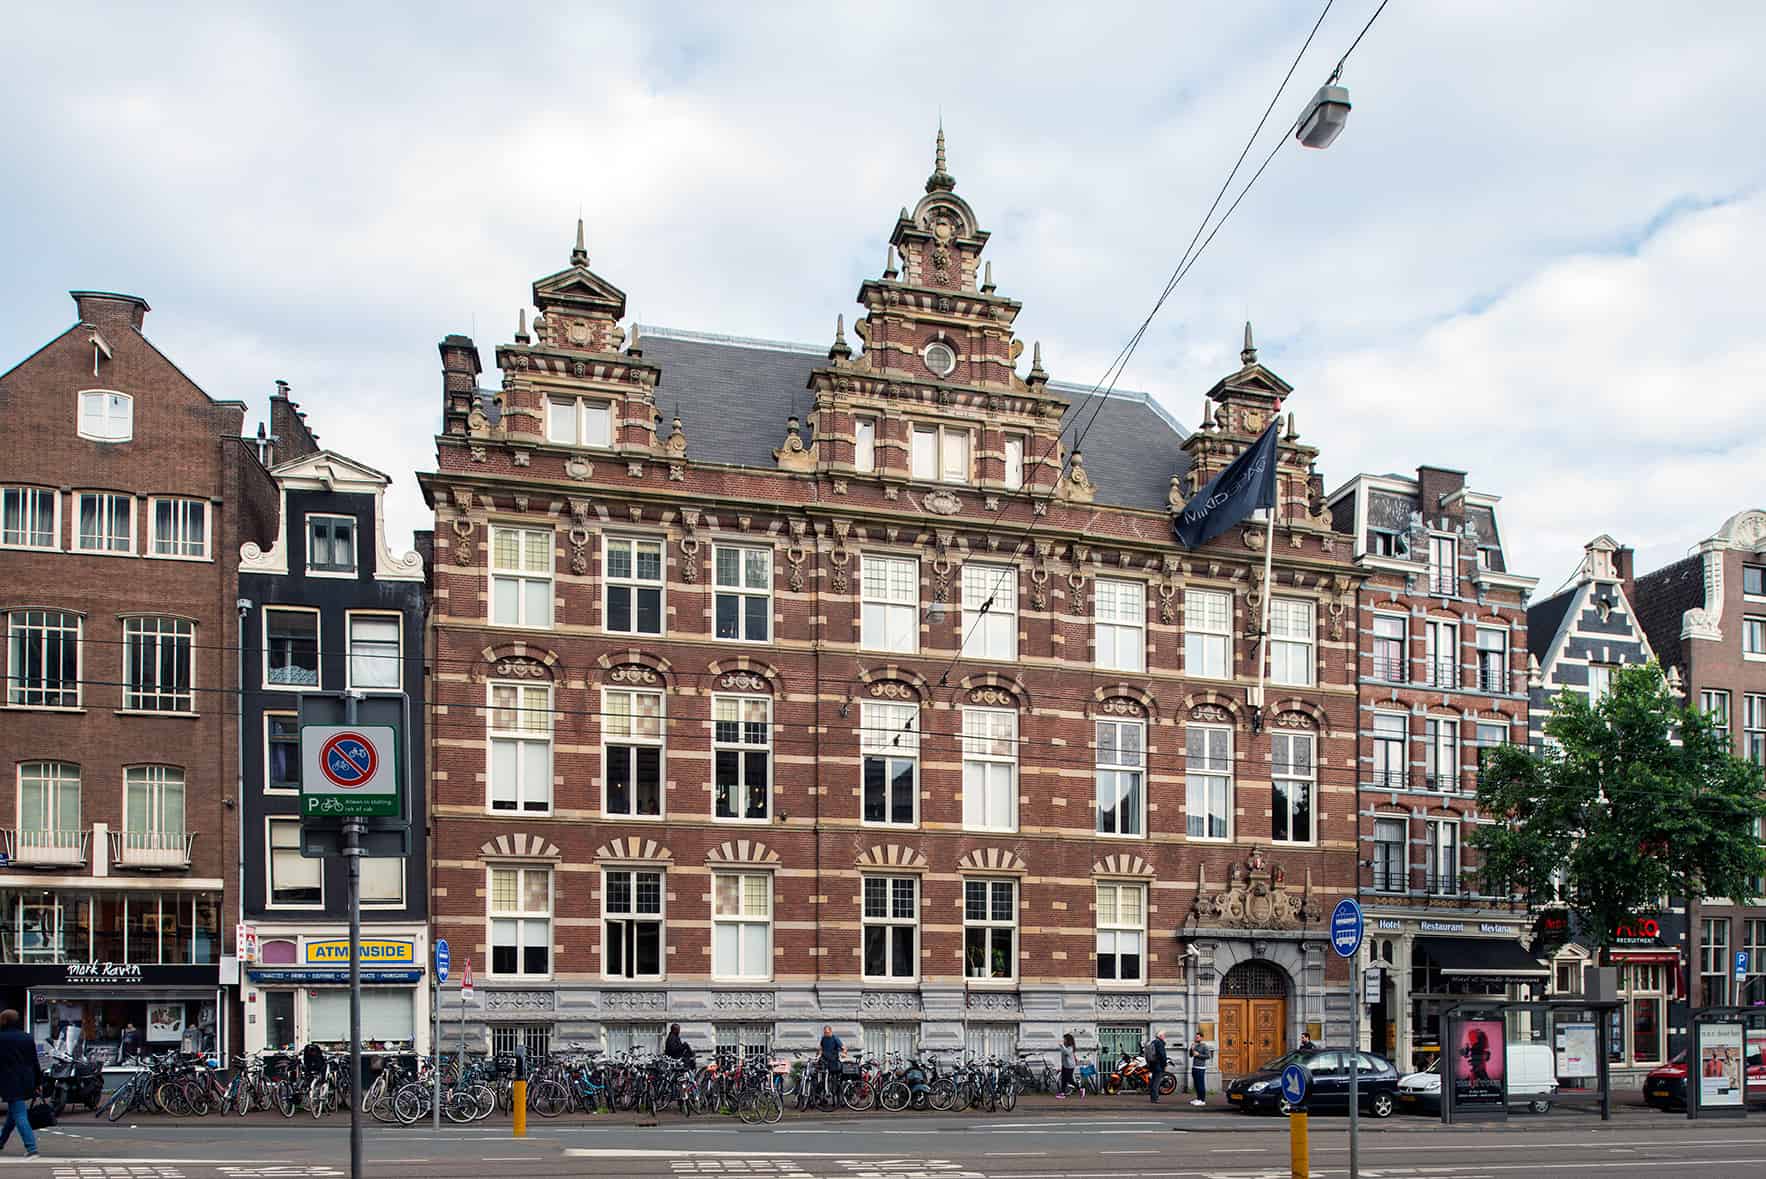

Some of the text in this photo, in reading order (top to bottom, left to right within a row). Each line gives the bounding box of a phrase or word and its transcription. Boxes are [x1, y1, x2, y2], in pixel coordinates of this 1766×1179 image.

[308, 797, 320, 812] P
[1379, 919, 1400, 929] Hotel
[1421, 920, 1464, 932] Restaurant
[315, 945, 405, 957] ATM NSIDE
[1738, 954, 1746, 965] P
[67, 959, 141, 976] Mark Raven
